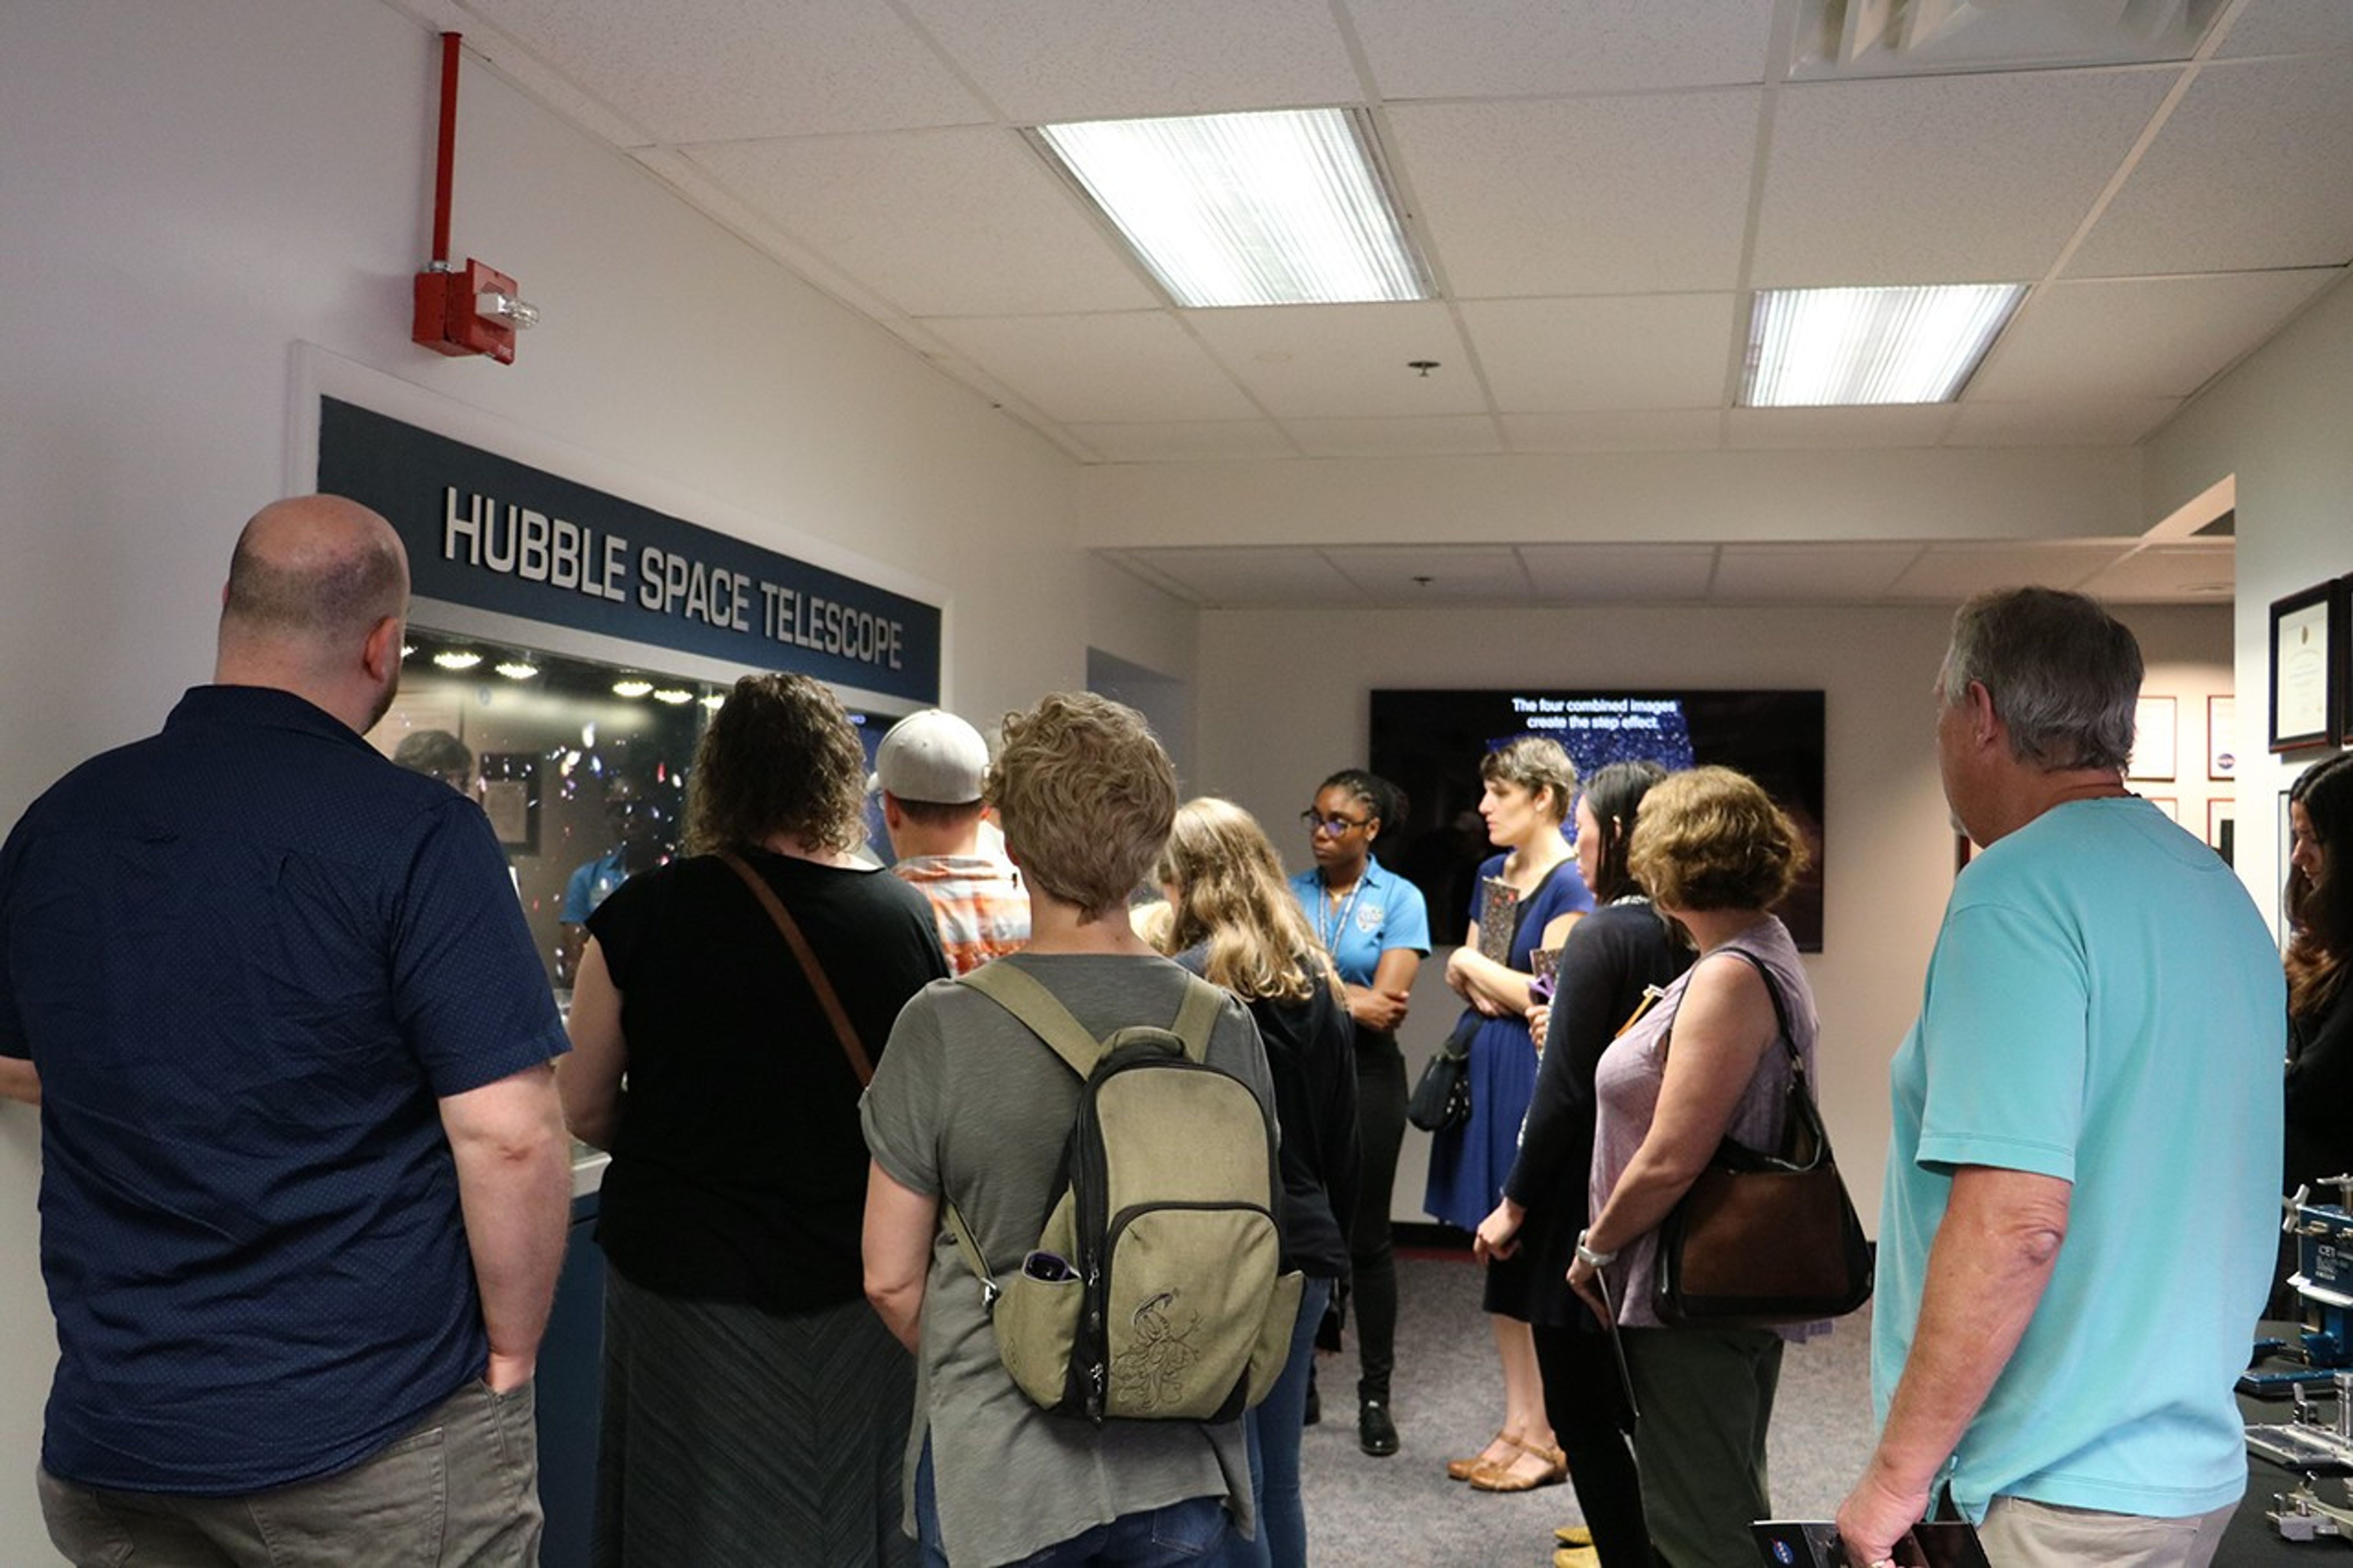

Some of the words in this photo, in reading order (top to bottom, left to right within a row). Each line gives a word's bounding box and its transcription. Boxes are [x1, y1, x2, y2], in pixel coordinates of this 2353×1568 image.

[444, 486, 627, 602] HUBBLE
[639, 546, 751, 633] SPACE
[760, 581, 902, 670] TELESCOPE
[1511, 697, 1537, 712] The
[1539, 697, 1565, 712] four
[1566, 699, 1628, 712] combined
[1630, 698, 1677, 715] images
[1527, 715, 1567, 729] create
[1569, 715, 1589, 729] the
[1592, 716, 1620, 731] step
[1621, 715, 1661, 730] effect.
